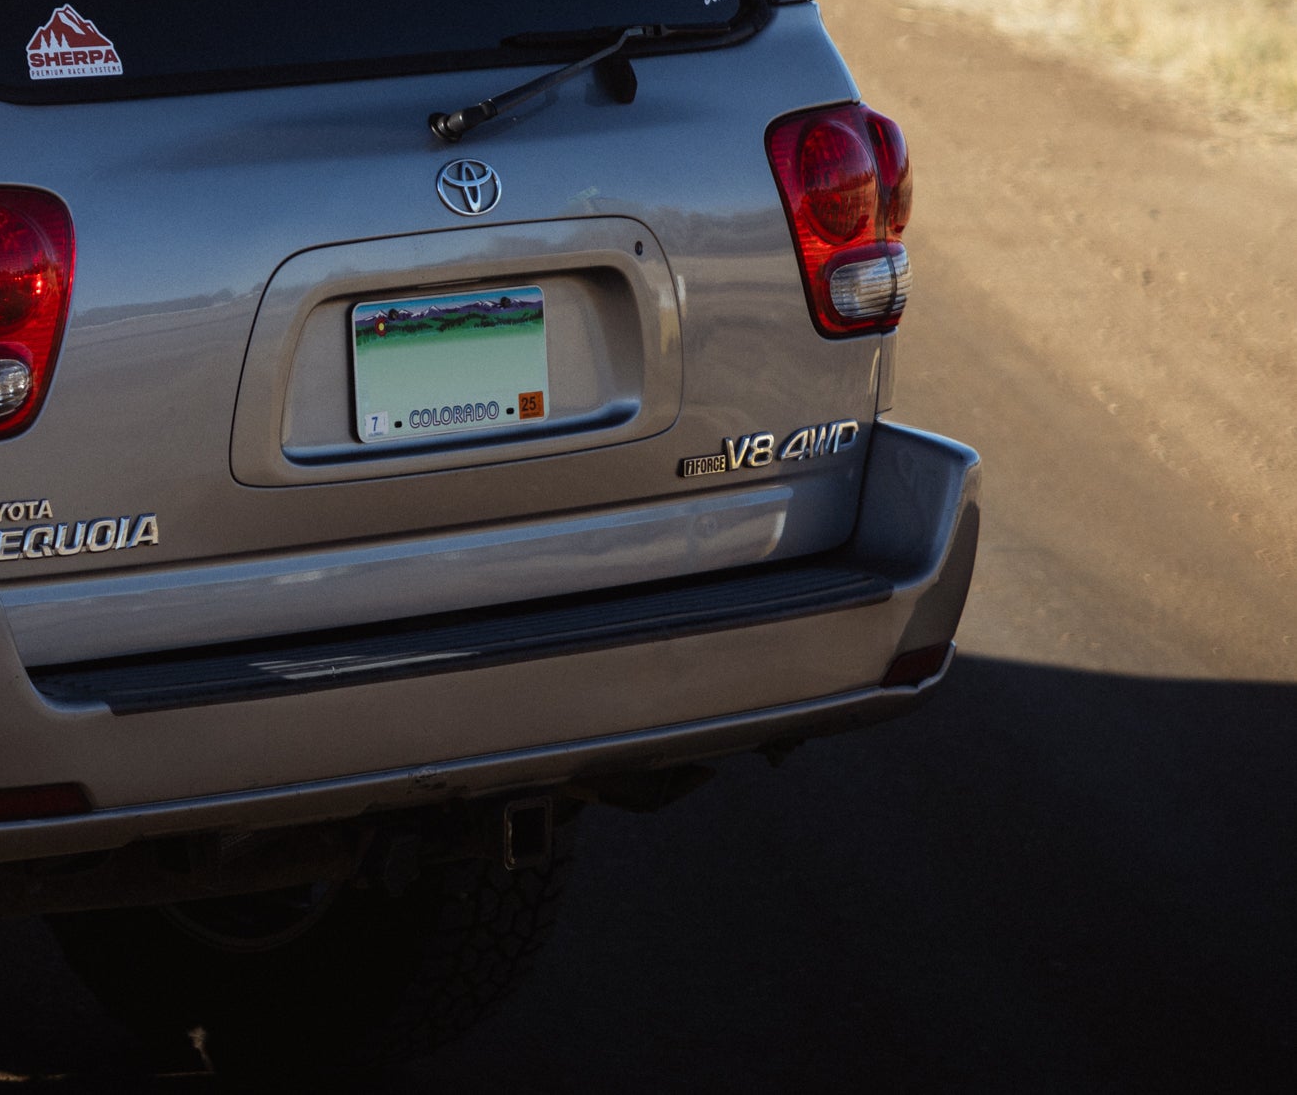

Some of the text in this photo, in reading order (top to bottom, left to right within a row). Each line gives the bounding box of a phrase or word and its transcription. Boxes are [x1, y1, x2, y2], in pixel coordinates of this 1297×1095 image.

[29, 49, 119, 68] SHERPA
[31, 65, 121, 77] PREMIUM RACK SYSTEMS
[521, 395, 537, 412] 25
[409, 400, 500, 429] COLORADO
[371, 416, 379, 432] 7
[724, 431, 775, 472] V8
[777, 419, 859, 460] 4WD
